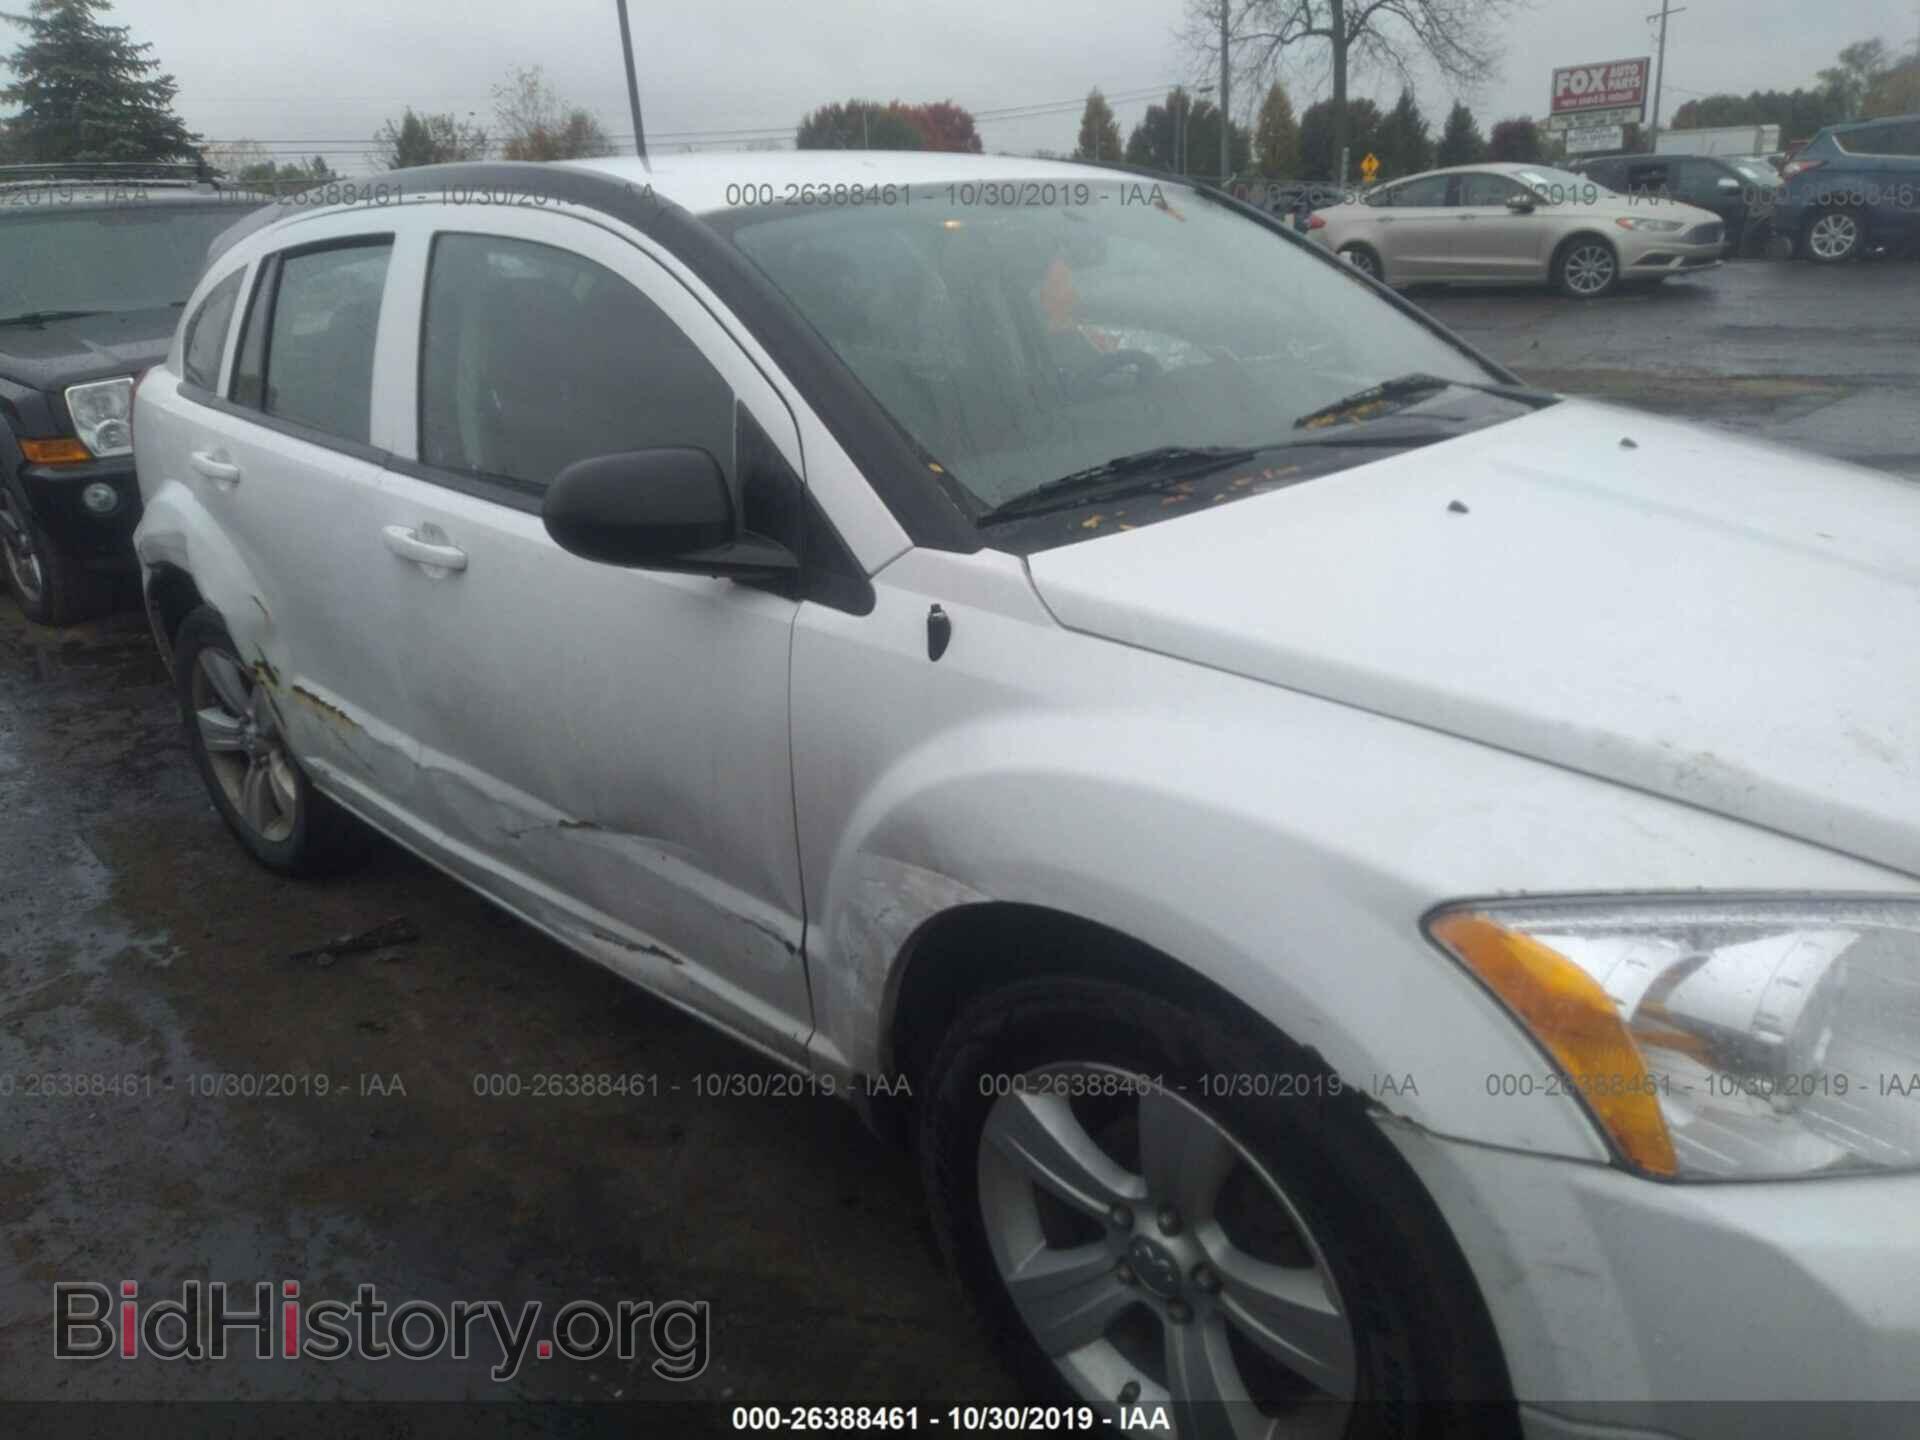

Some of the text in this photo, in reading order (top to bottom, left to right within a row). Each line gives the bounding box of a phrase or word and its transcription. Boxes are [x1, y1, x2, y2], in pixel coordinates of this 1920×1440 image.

[1609, 63, 1639, 78] AUTO
[1556, 68, 1606, 97] FOX
[1608, 76, 1641, 91] PARTS
